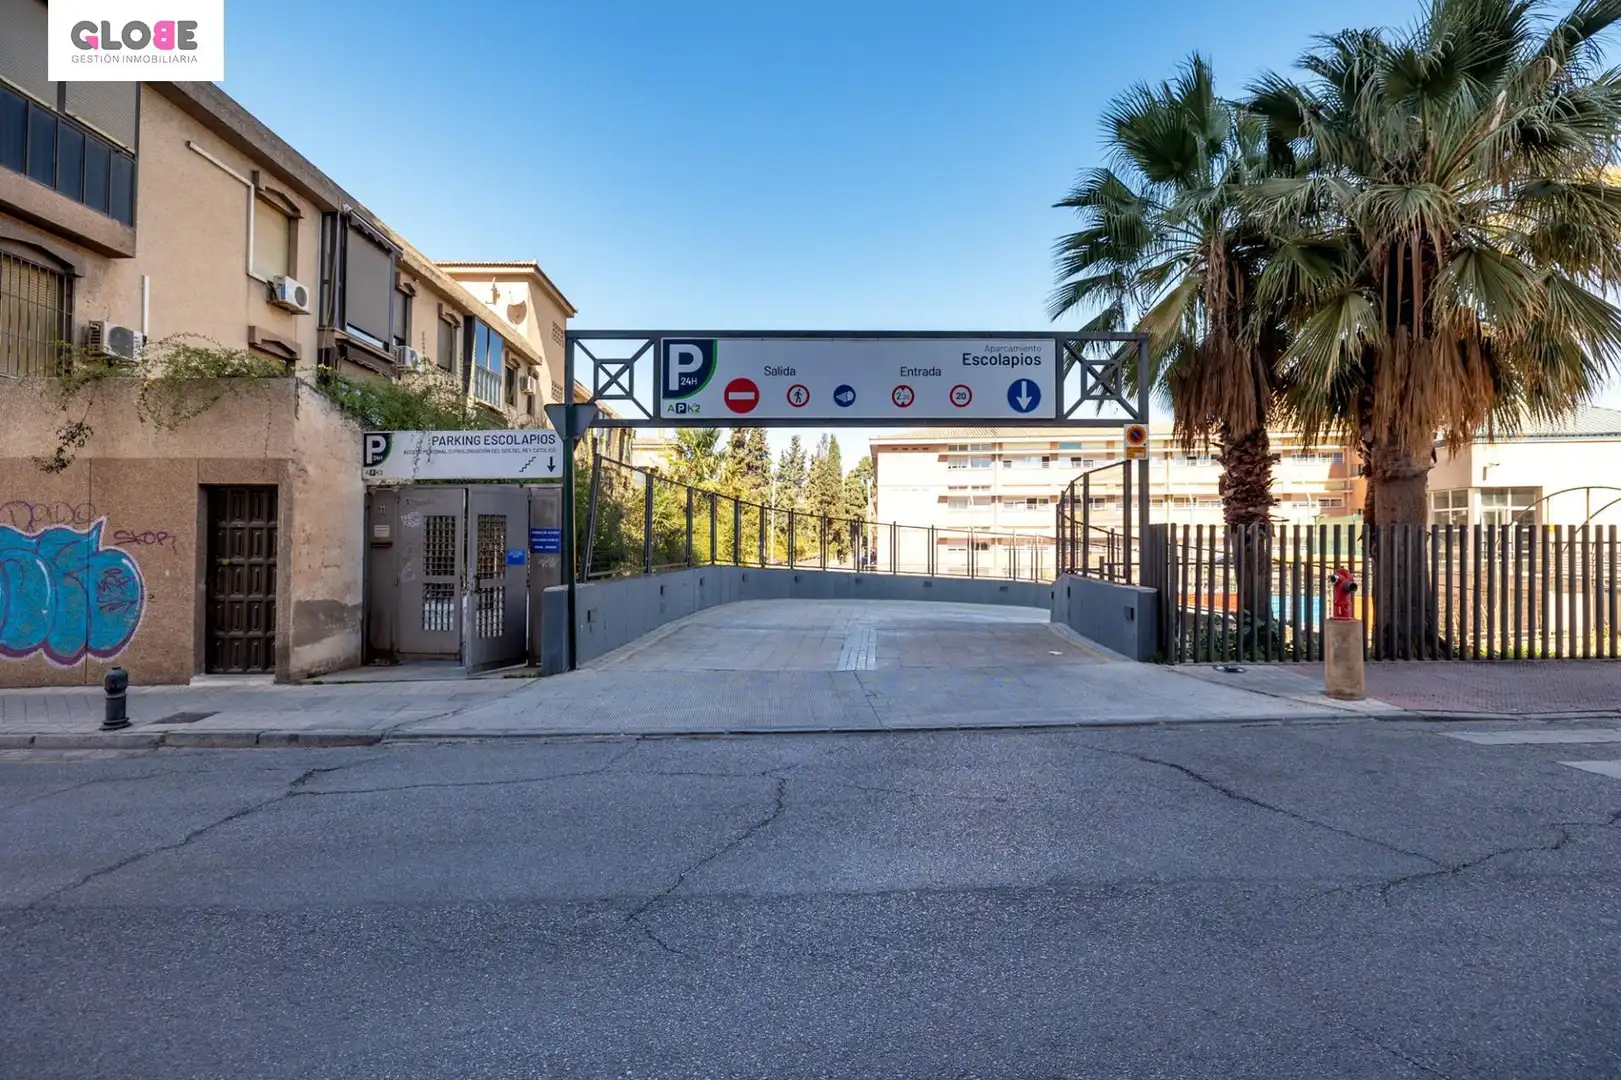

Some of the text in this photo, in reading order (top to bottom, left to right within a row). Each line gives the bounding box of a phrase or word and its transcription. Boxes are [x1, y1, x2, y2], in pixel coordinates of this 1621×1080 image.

[984, 344, 1042, 354] Aparcamiento
[962, 353, 1042, 368] Escolapios
[668, 344, 704, 391] P
[764, 365, 796, 377] Salida
[900, 366, 942, 377] Entrada
[680, 376, 698, 386] 24H
[955, 392, 967, 400] 20
[432, 434, 556, 446] PARKING ESCOLAPIOS
[366, 435, 386, 464] P
